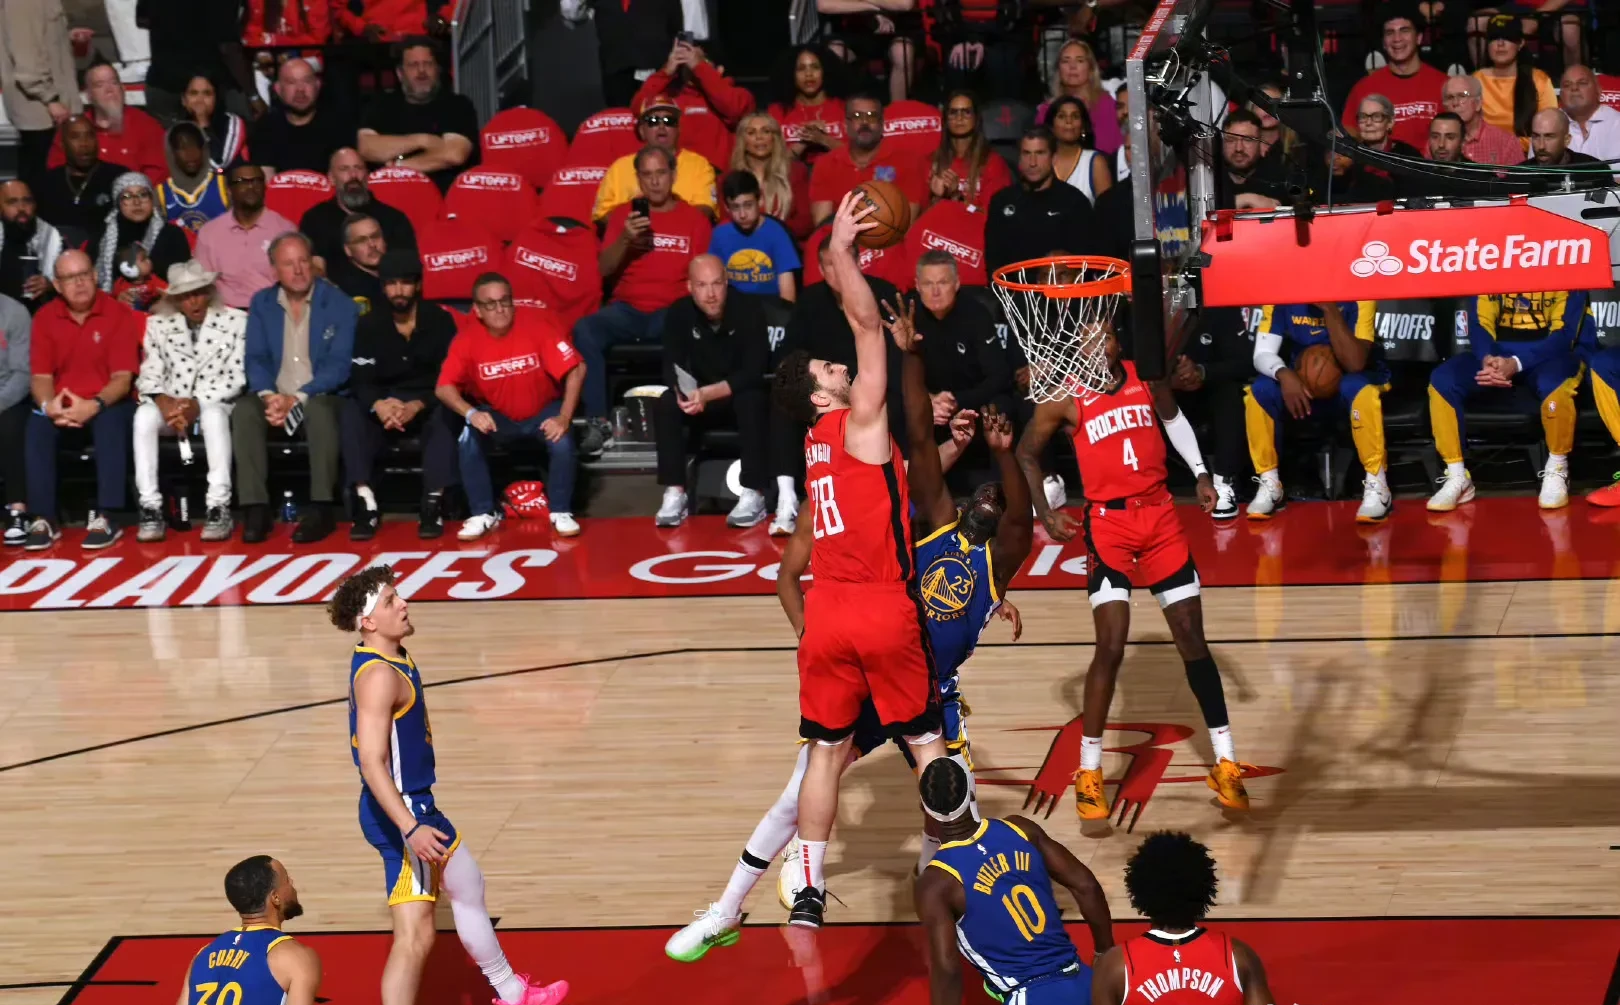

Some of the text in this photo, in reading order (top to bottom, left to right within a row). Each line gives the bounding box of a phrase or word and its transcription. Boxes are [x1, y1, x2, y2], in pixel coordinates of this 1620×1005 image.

[1407, 234, 1591, 274] State Farm
[1375, 312, 1435, 340] LAYOFFS
[1085, 404, 1153, 445] ROCKETS
[1123, 437, 1139, 471] 4
[811, 475, 845, 540] 28
[949, 575, 973, 595] 23
[973, 850, 1030, 895] BUTLER III
[1002, 884, 1046, 942] 10
[208, 948, 250, 969] CURRY
[1136, 967, 1225, 1003] THOMPSON
